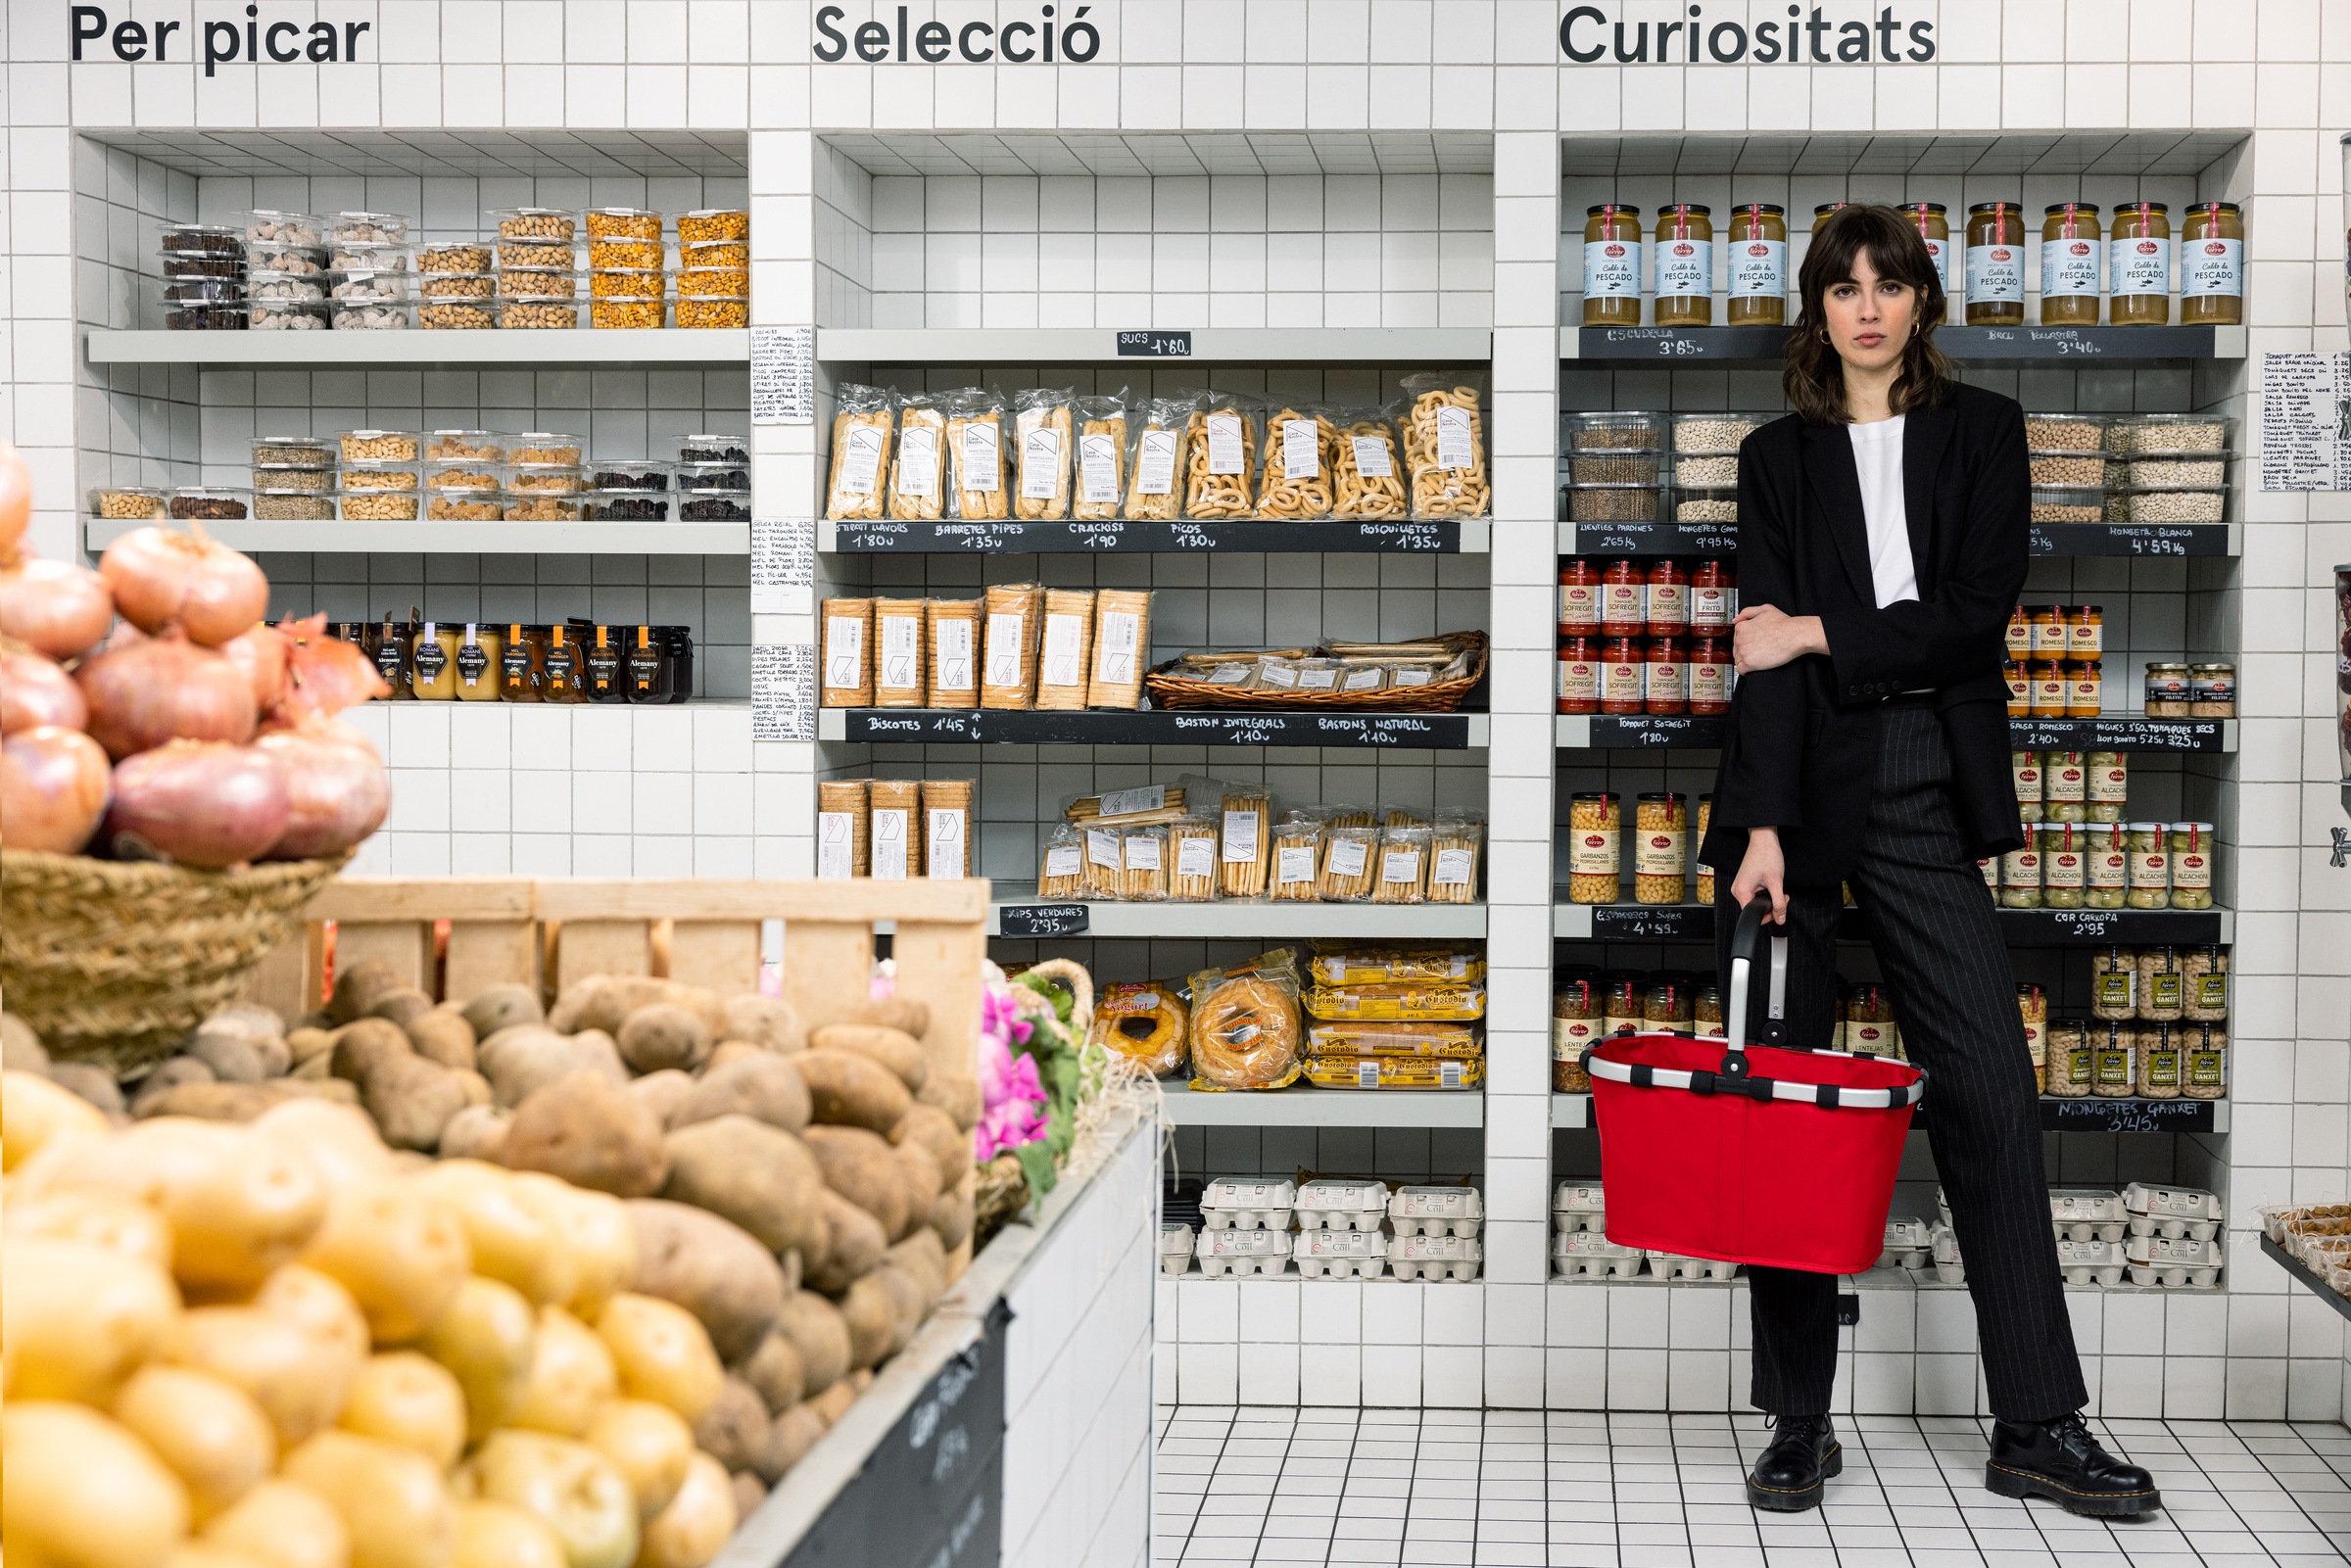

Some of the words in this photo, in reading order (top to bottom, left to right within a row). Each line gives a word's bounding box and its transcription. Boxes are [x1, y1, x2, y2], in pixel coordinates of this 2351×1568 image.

[812, 4, 1100, 63] Selecció
[1559, 4, 1936, 63] Curiositats
[71, 5, 180, 62] Per
[205, 4, 370, 77] picar
[2127, 270, 2164, 279] PESCADO
[1121, 333, 1148, 344] SUCS
[935, 525, 986, 536] BARRETES
[2158, 528, 2193, 537] BLANCA
[1083, 534, 1117, 547] 1'90
[415, 655, 444, 664] Alemany
[457, 656, 486, 666] Alemany
[933, 717, 965, 732] 1'45
[1176, 717, 1219, 729] BASTON
[1223, 718, 1286, 730] INTEGRALS
[1319, 718, 1367, 731] BASTONS
[1375, 719, 1431, 732] NATURAL
[2196, 725, 2215, 734] SECS
[1037, 907, 1083, 918] VERDURES
[2054, 913, 2076, 923] COR
[2073, 923, 2105, 935] 2'95
[1425, 995, 1467, 1004] Custodio
[1111, 1002, 1149, 1014] Yogurt
